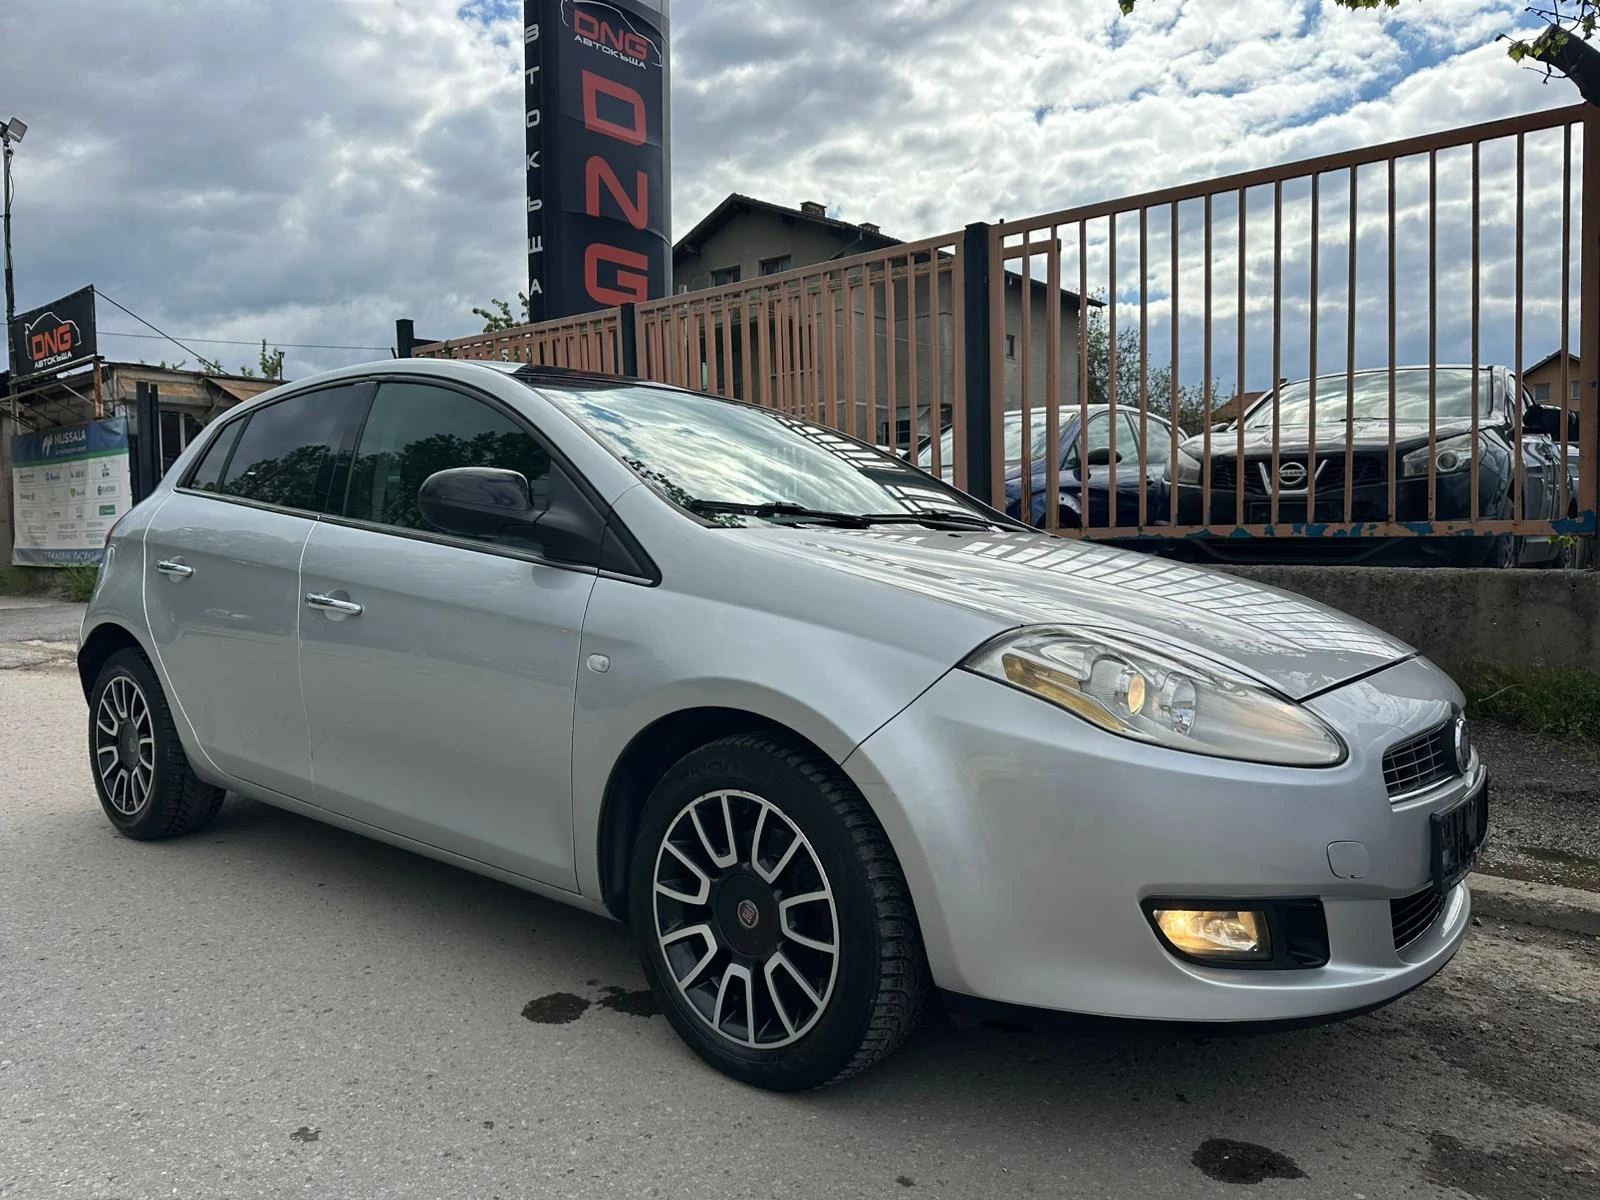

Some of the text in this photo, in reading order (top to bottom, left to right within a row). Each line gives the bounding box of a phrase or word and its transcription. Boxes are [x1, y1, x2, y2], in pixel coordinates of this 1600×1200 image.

[574, 9, 648, 60] DNG
[582, 69, 648, 306] DNG
[31, 323, 72, 361] DNG
